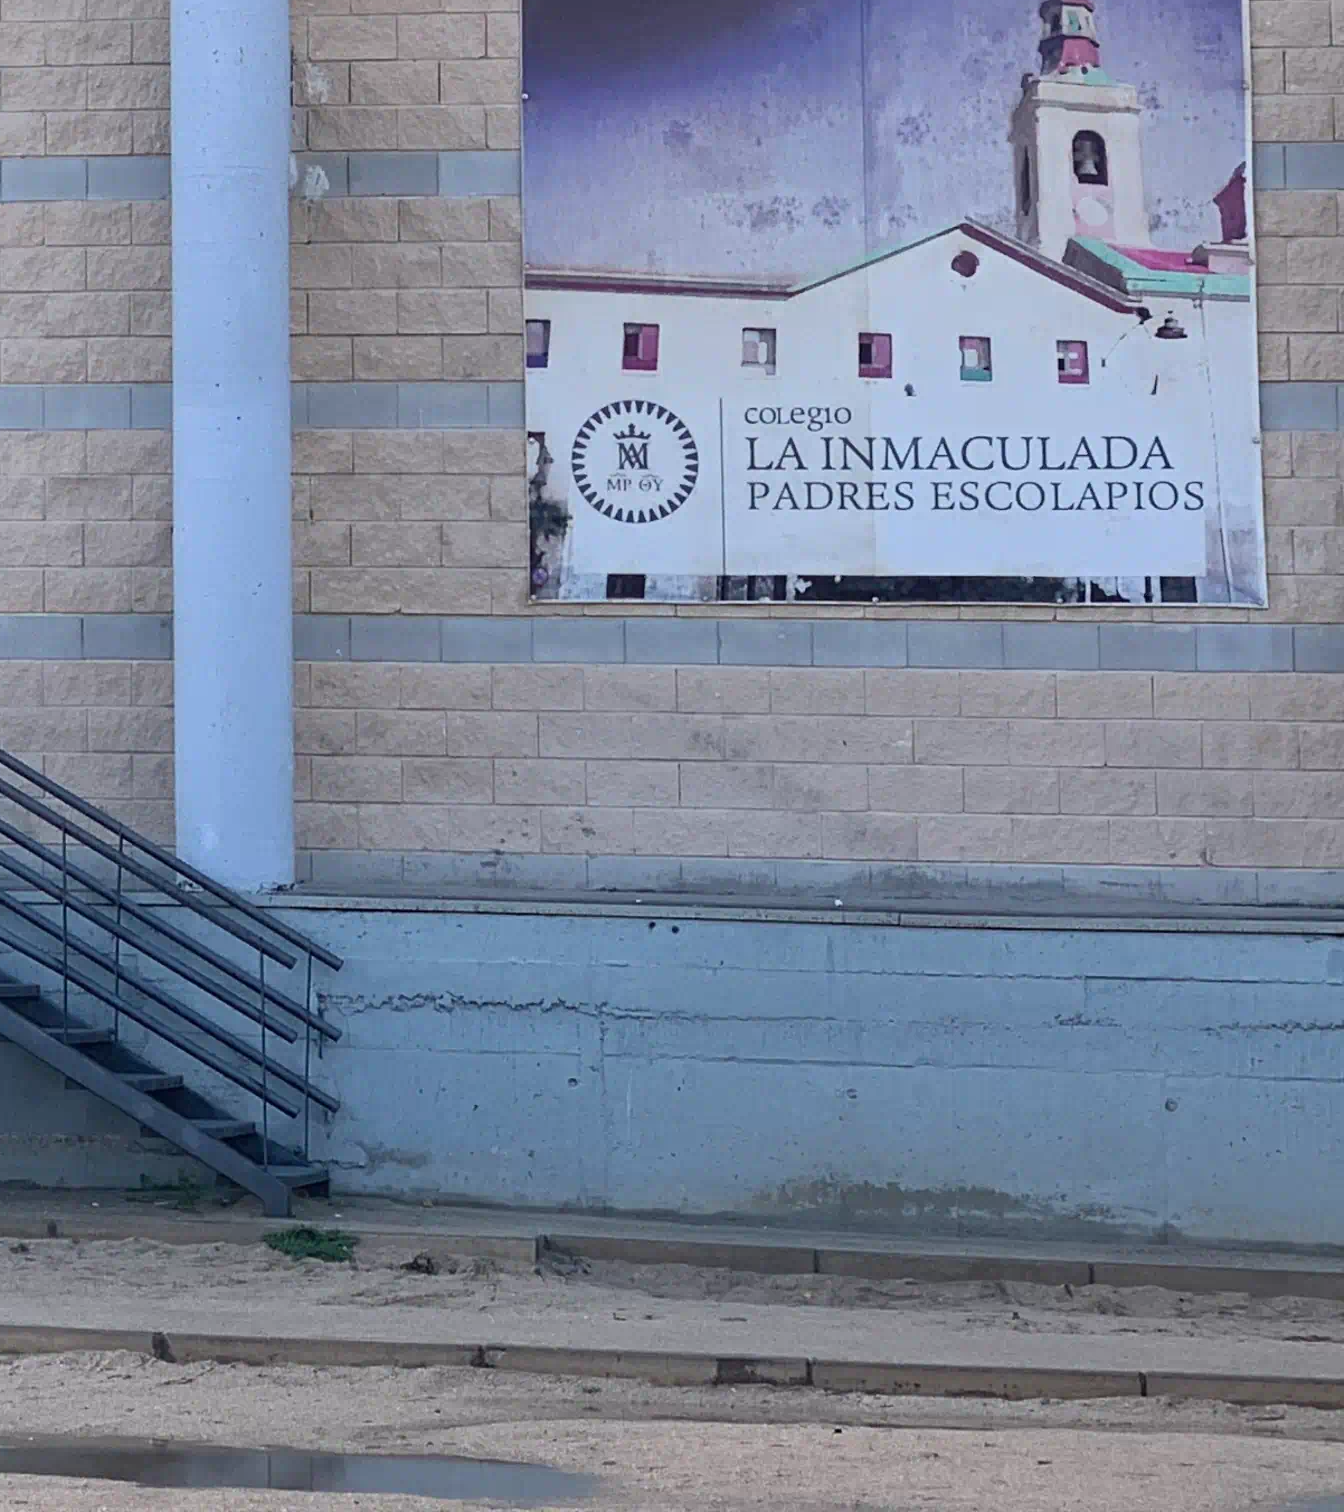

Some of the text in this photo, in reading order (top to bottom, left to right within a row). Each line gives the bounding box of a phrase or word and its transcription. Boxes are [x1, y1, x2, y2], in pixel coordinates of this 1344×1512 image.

[745, 435, 1175, 471] LA INMACULADA
[746, 480, 1205, 511] PADRES ESCOLAPIOS
